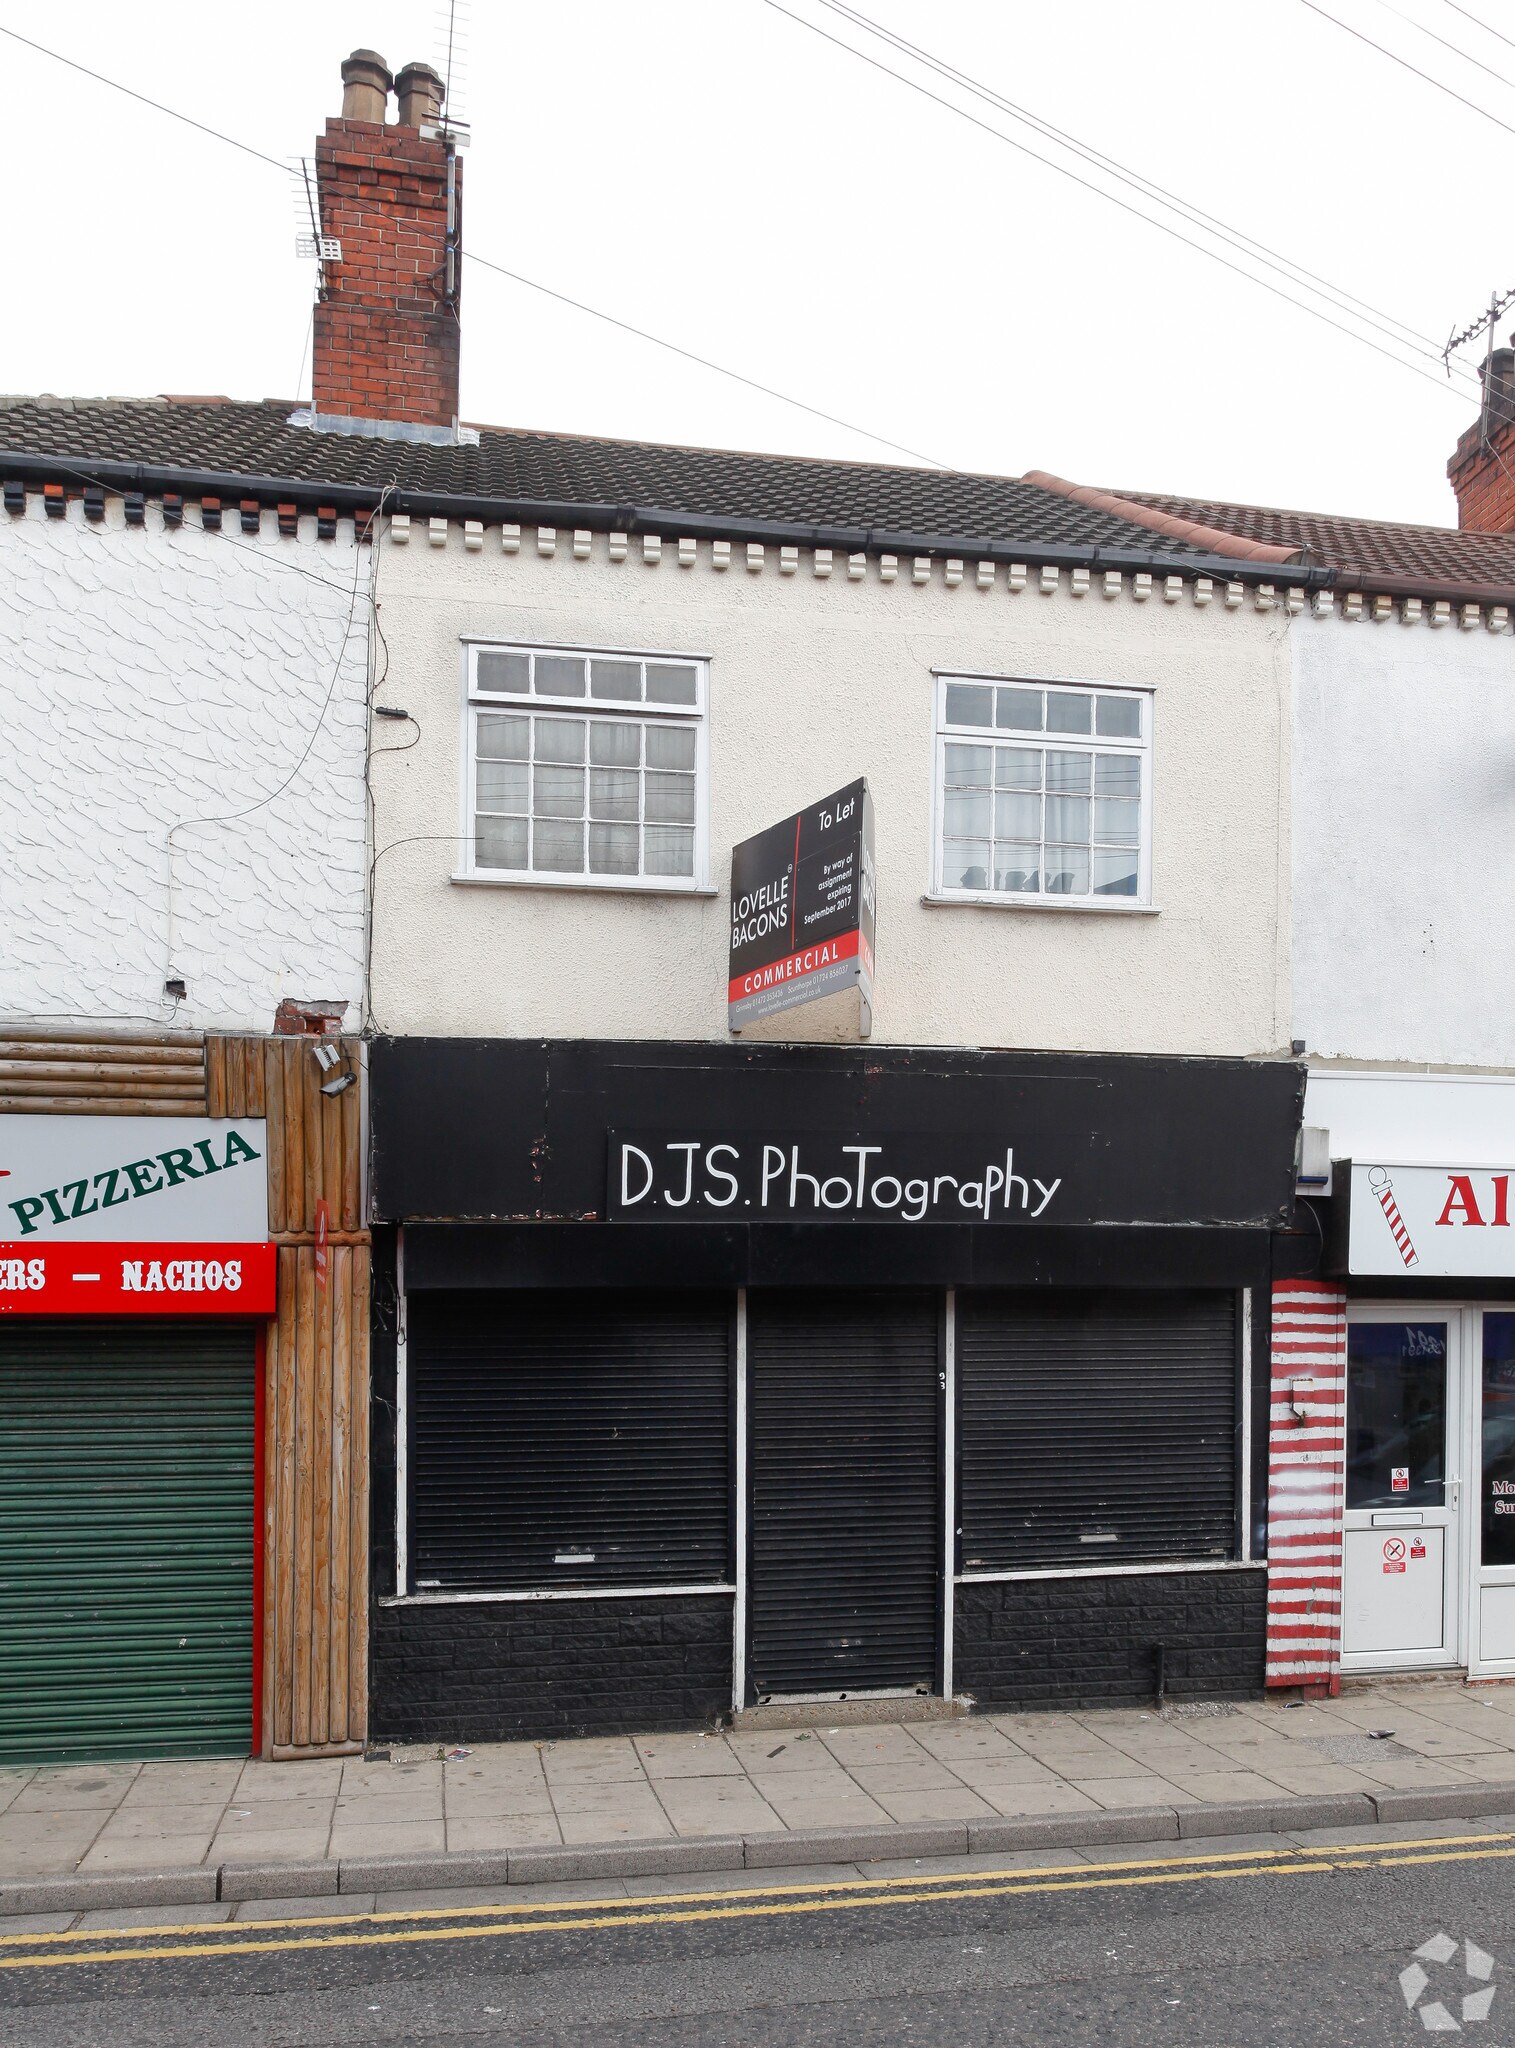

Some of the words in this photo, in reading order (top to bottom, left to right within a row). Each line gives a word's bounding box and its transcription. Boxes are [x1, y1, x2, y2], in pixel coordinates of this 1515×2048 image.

[819, 810, 832, 831] To
[836, 797, 855, 823] Let
[818, 867, 852, 891] assignment
[823, 865, 831, 875] By
[832, 858, 845, 871] way
[846, 852, 853, 864] of
[733, 875, 789, 923] LOVELLE
[827, 883, 852, 901] expiring
[732, 903, 788, 949] BACONS
[804, 904, 836, 924] September
[837, 896, 852, 911] 2017
[744, 943, 839, 993] COMMERCIAL
[8, 1130, 262, 1235] PIZZERIA
[120, 1260, 242, 1292] NACHOS
[1494, 1500, 1515, 1515] Su
